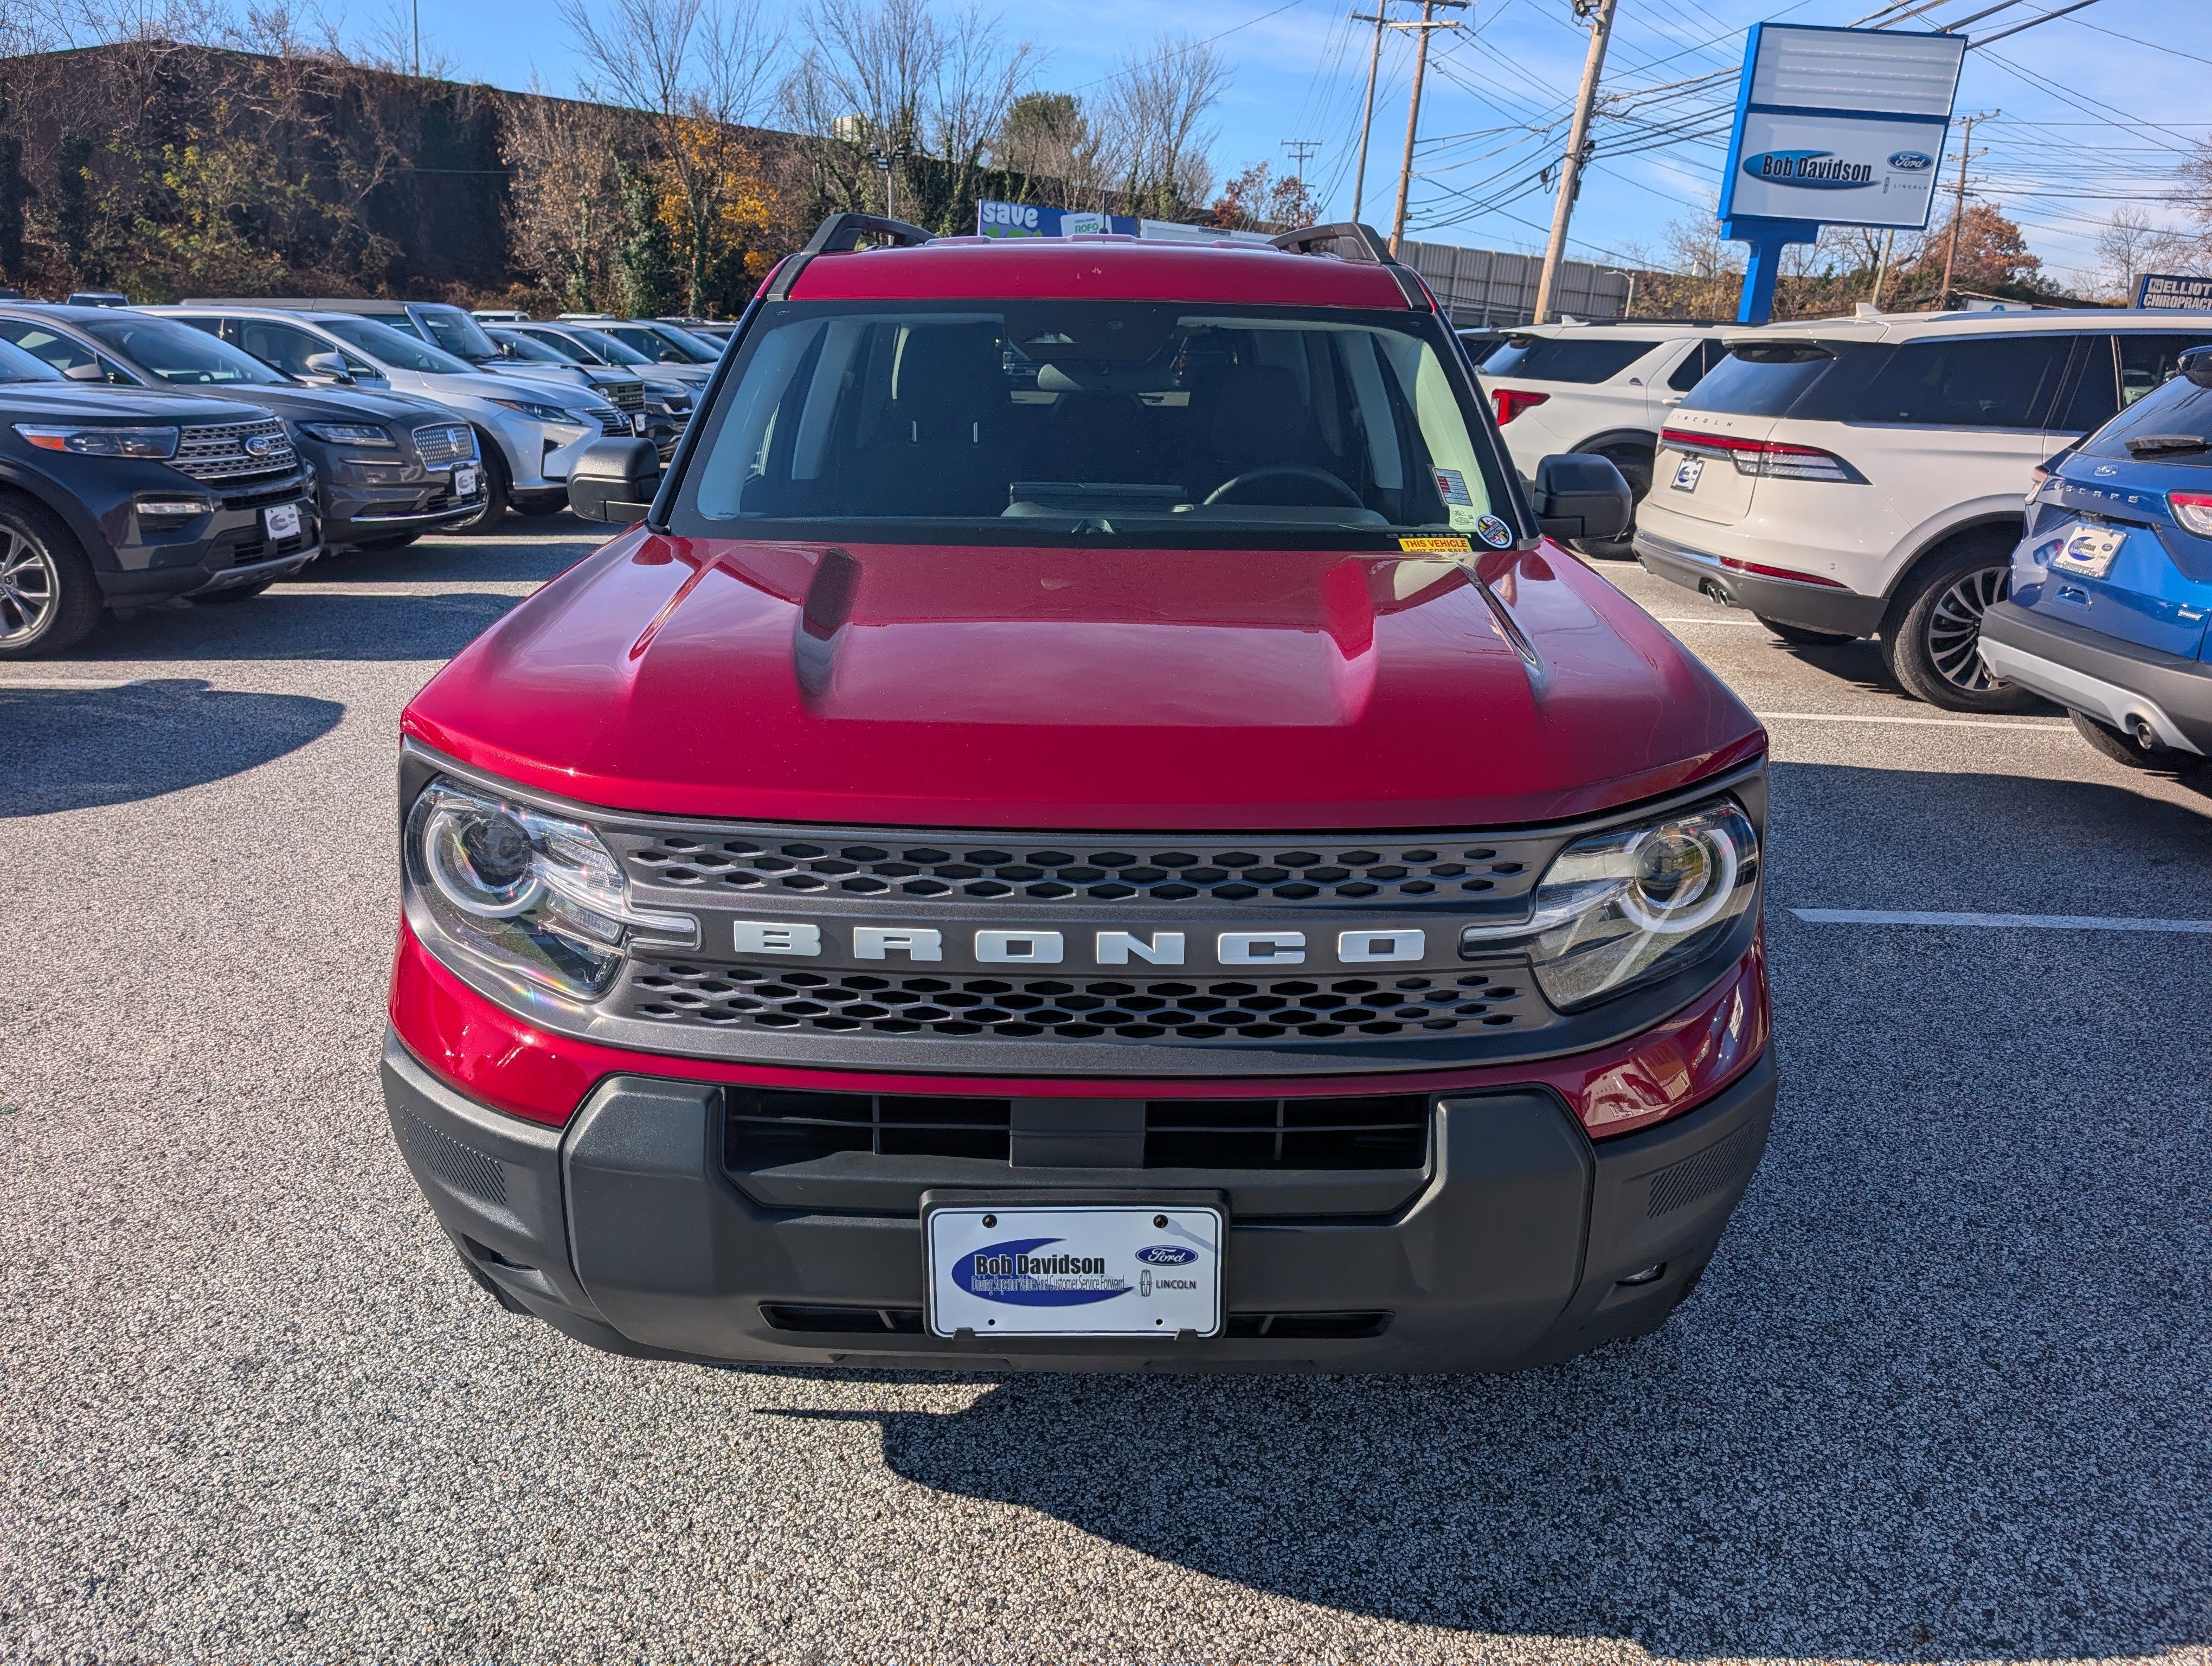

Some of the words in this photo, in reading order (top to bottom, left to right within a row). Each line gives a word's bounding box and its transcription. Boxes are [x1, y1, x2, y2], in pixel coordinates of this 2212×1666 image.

[1895, 153, 1926, 168] Ford
[1762, 155, 1792, 177] Bob
[1797, 157, 1872, 182] Davidson
[982, 202, 1038, 228] save
[1075, 222, 1099, 234] ROFO
[1670, 414, 1733, 427] LINCOLN
[1403, 540, 1427, 548] THIS
[1427, 539, 1468, 548] VEHICLE
[734, 920, 1425, 965] BRONCO
[1148, 1248, 1186, 1263] Ford
[974, 1254, 1013, 1276] Bob
[1016, 1253, 1105, 1275] Davidson
[971, 1275, 994, 1296] Driving
[993, 1276, 1019, 1296] Superior
[1018, 1275, 1036, 1291] Value
[1036, 1275, 1049, 1291] And
[1049, 1276, 1079, 1291] Customer
[1078, 1276, 1100, 1291] Service
[1100, 1275, 1125, 1291] Forward
[1155, 1279, 1197, 1290] LINCOLN
